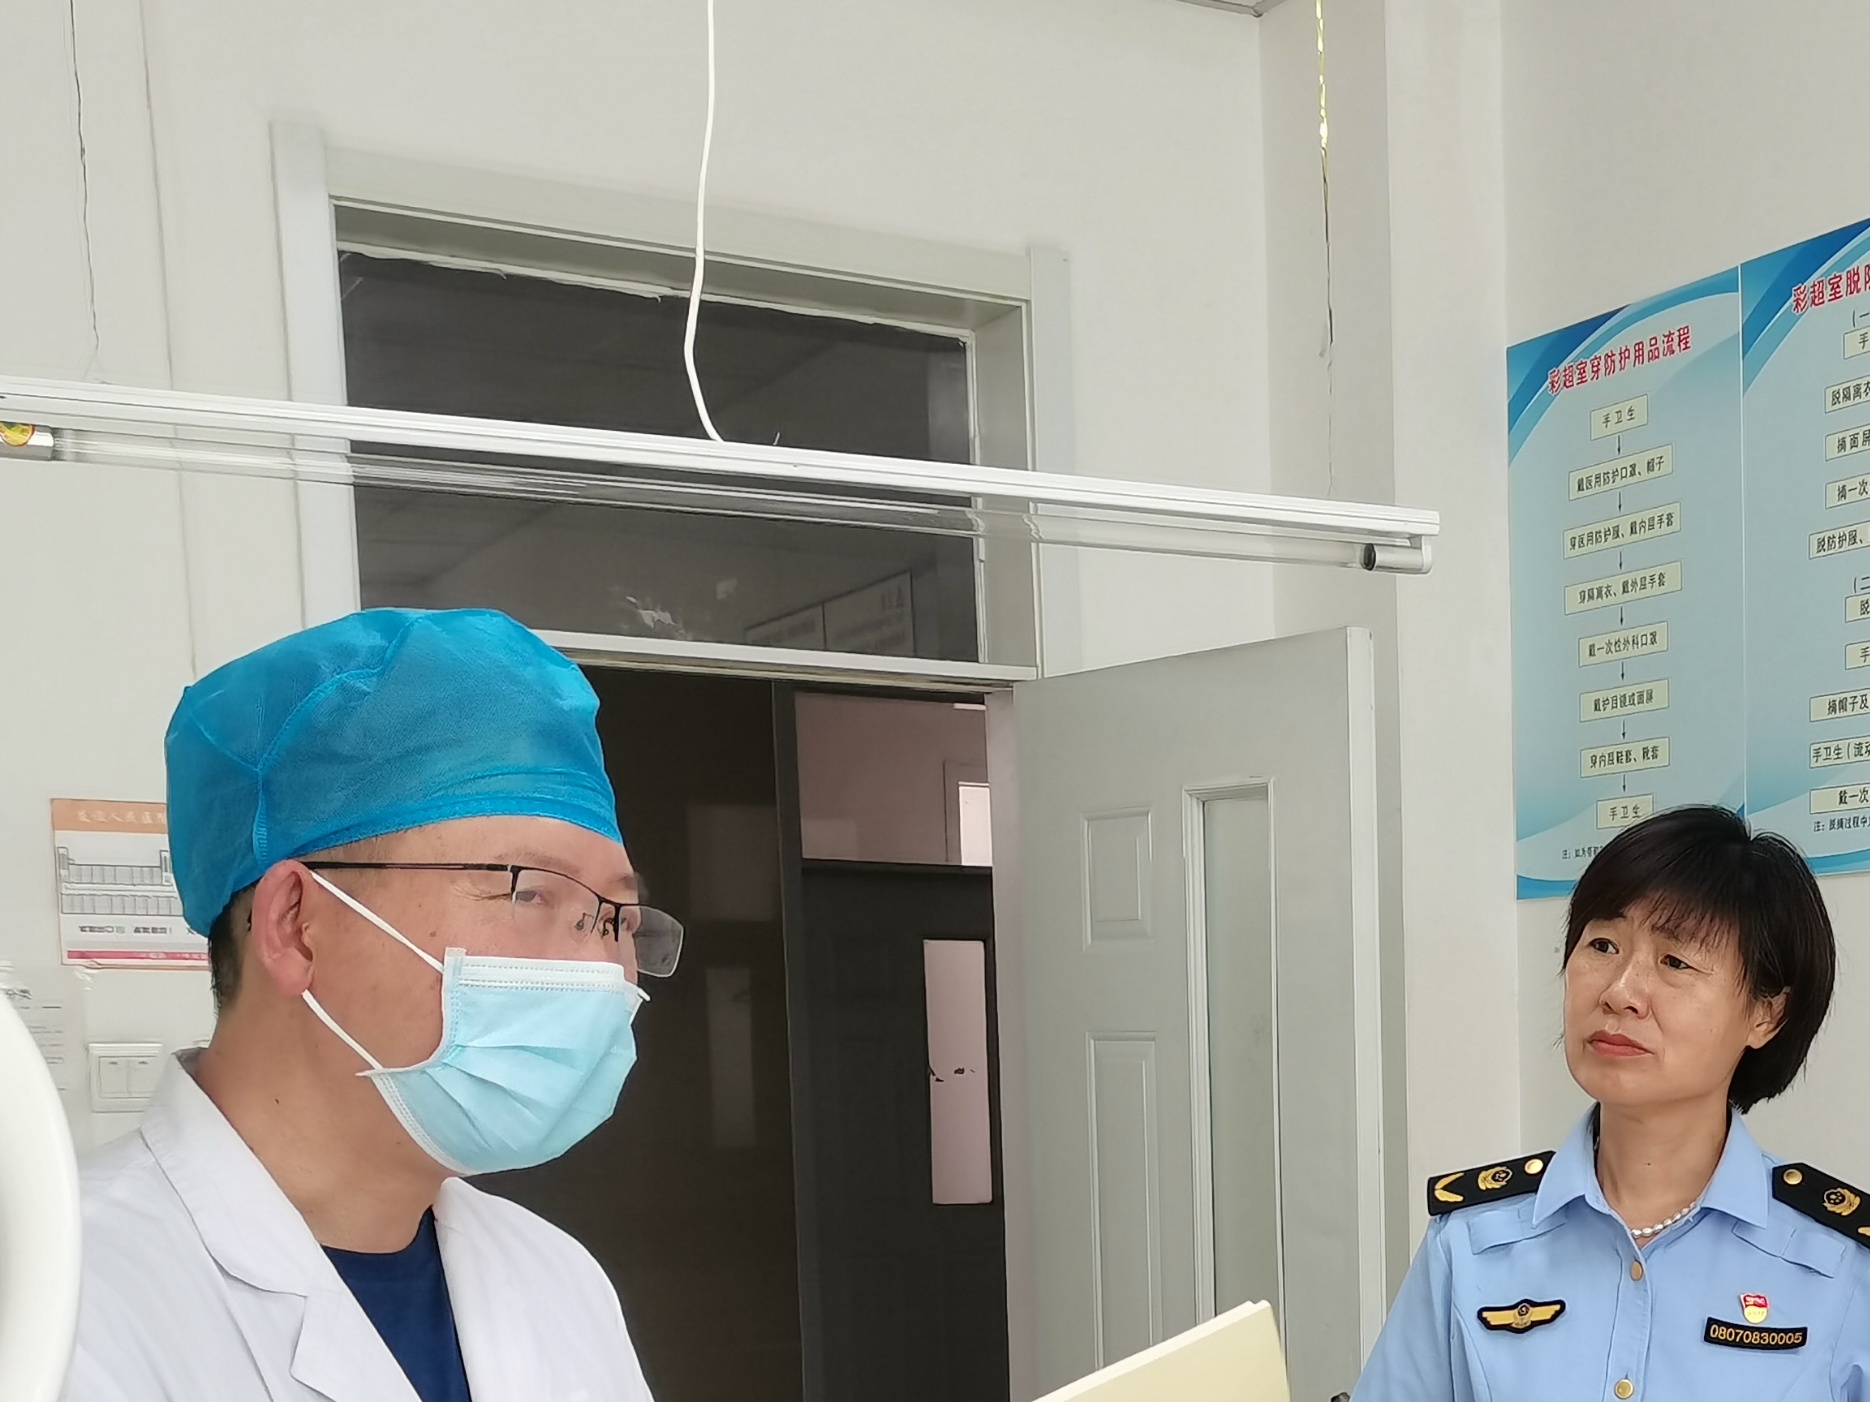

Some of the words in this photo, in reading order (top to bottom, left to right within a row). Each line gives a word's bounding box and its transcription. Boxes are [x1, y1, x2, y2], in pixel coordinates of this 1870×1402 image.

[1548, 325, 1692, 394] 彩超室穿防护用品流程
[1710, 1324, 1803, 1345] 08070830005
